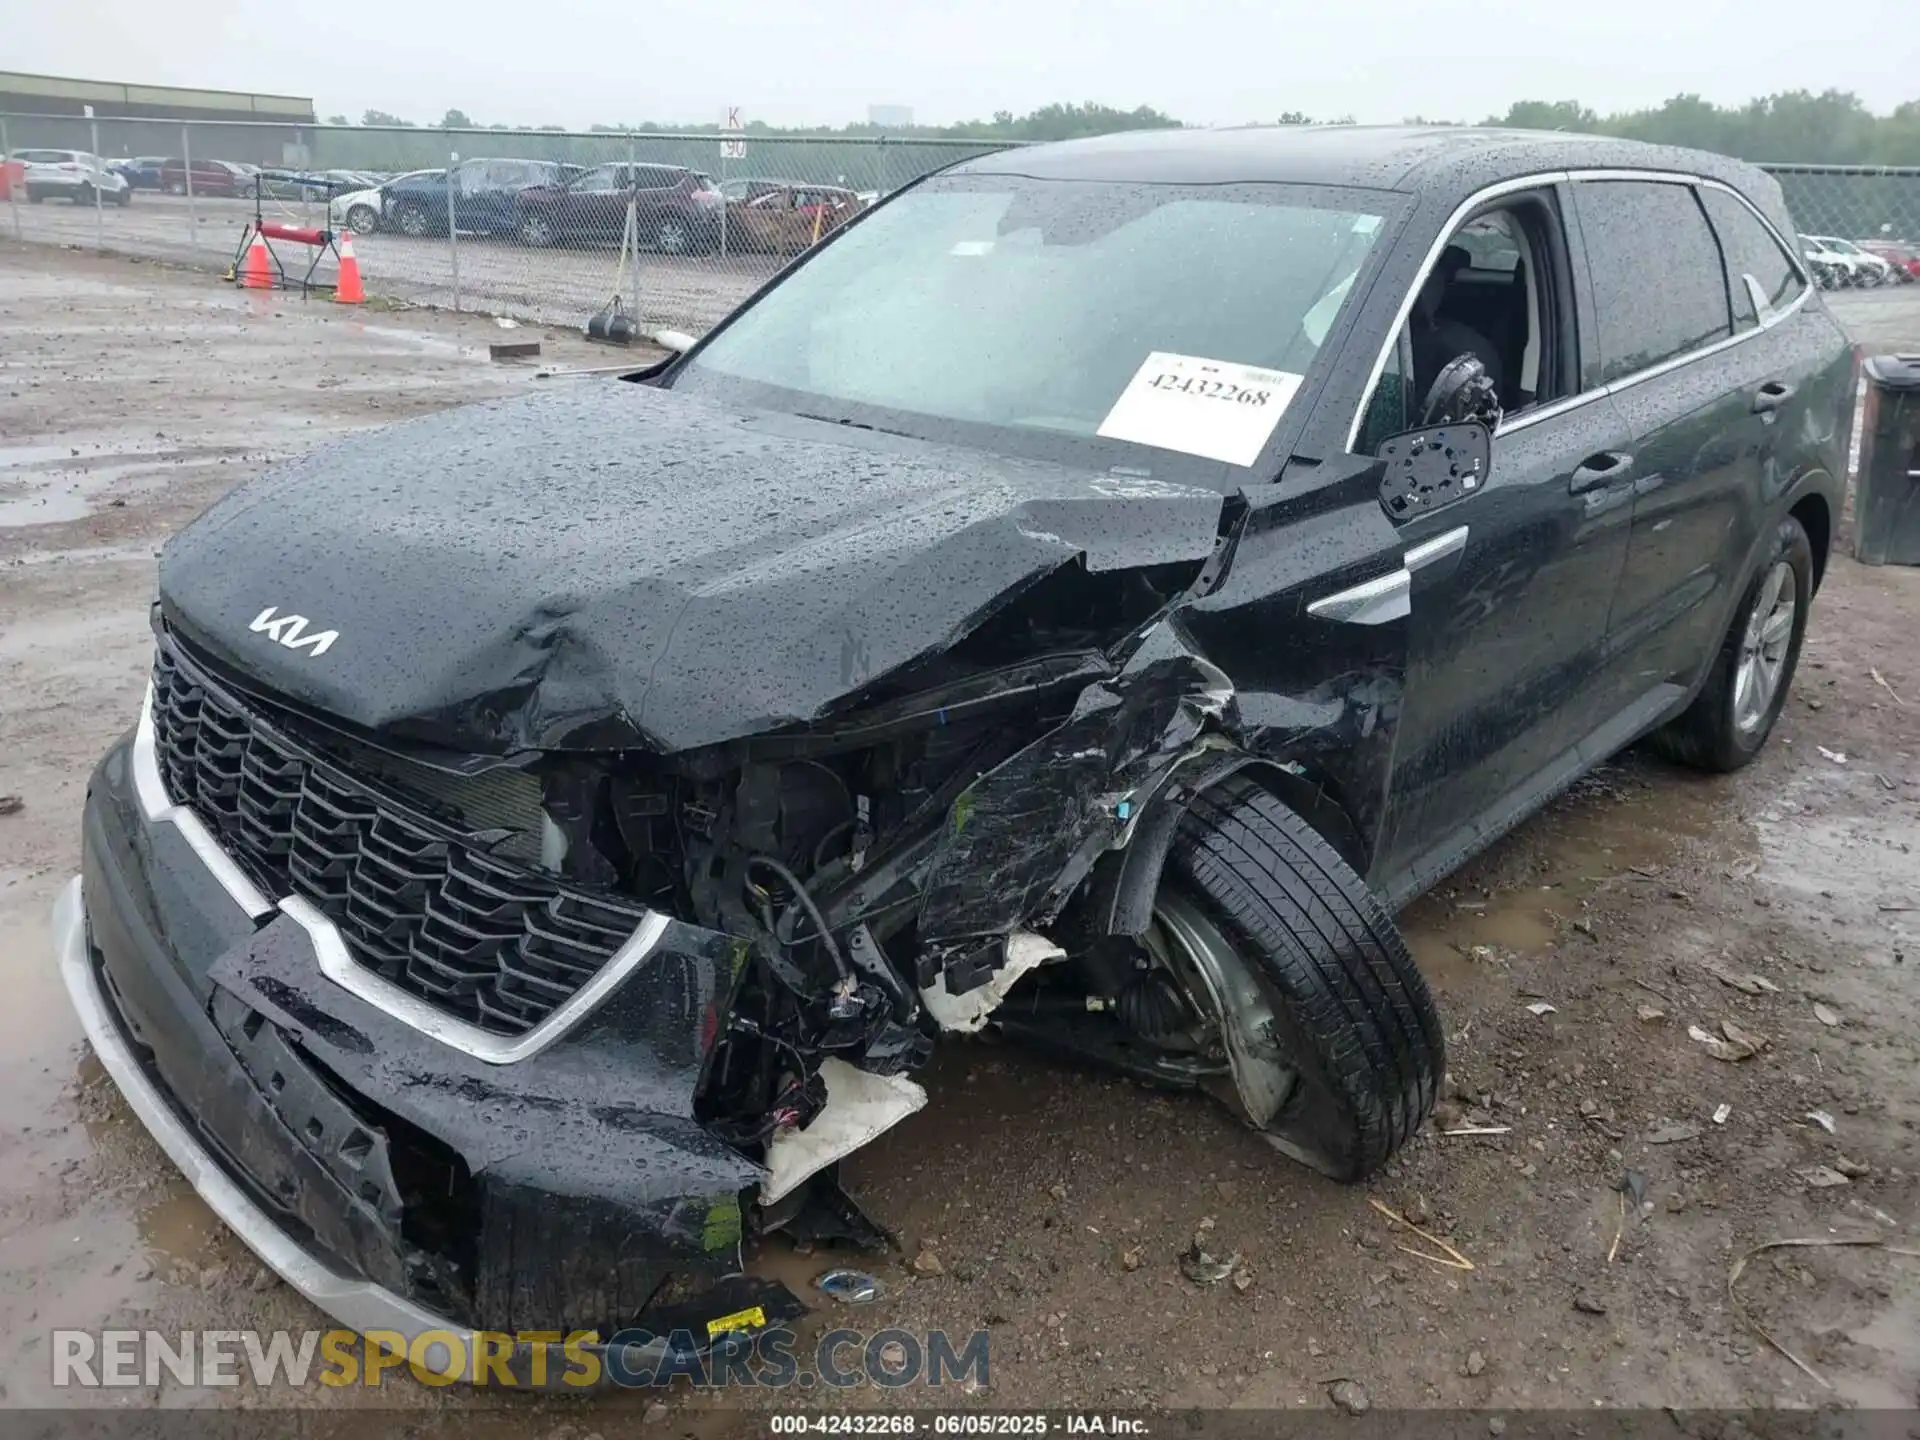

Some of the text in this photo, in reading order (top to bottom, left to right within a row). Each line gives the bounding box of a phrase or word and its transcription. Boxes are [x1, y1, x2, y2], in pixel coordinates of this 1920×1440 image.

[728, 106, 741, 129] K
[726, 139, 745, 157] 90
[1148, 373, 1271, 407] 42432268
